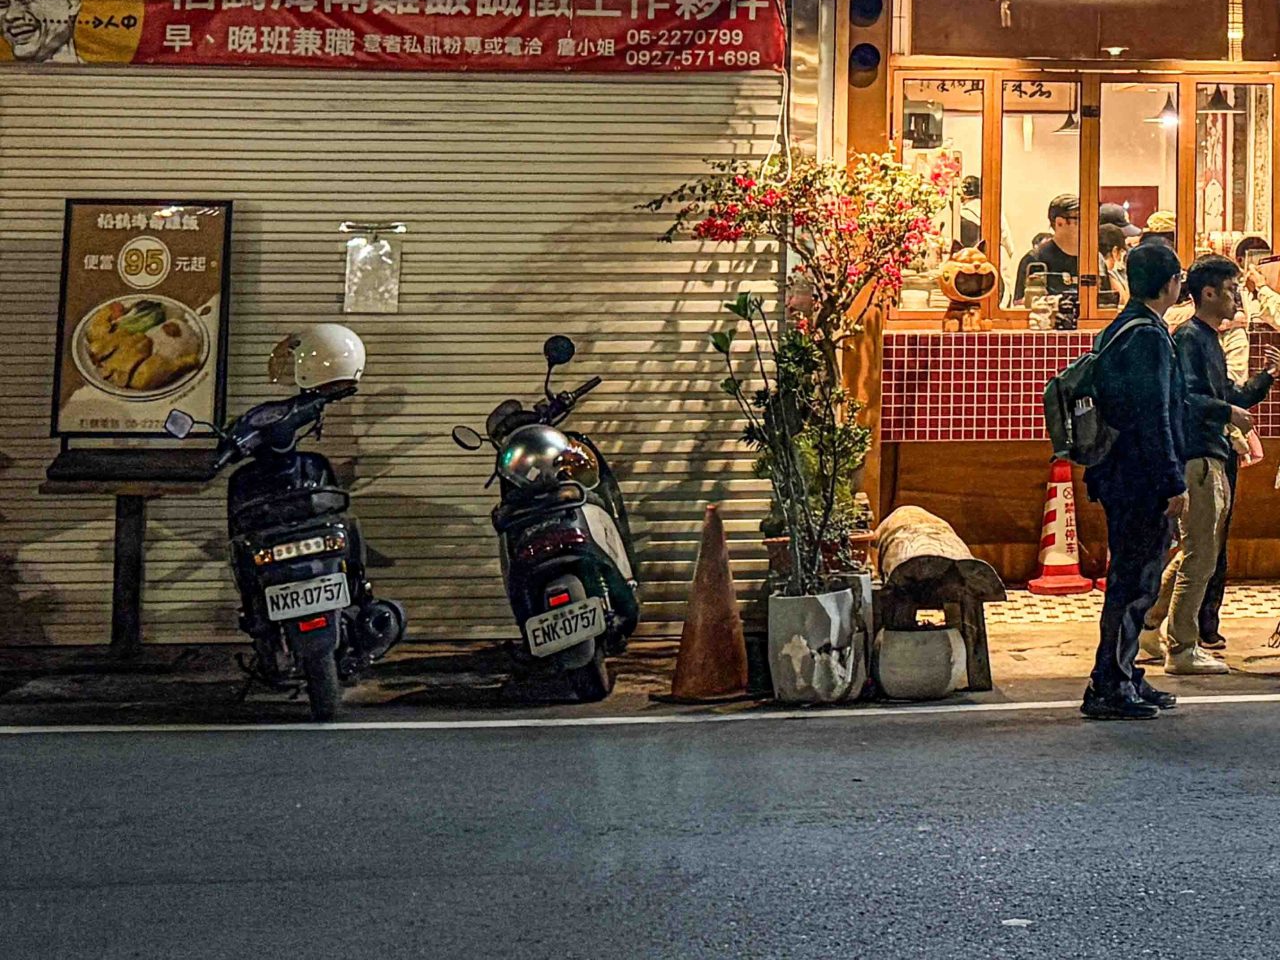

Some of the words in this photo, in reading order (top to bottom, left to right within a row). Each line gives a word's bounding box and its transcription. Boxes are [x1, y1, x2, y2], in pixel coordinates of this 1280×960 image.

[163, 24, 355, 56] 早、晚班兼職
[626, 29, 744, 46] 05-2270799
[625, 50, 761, 66] 0927-571-698
[124, 248, 165, 276] 95
[175, 257, 206, 272] 元起
[268, 582, 342, 613] NXR-0757
[531, 607, 597, 648] ENK-0757
